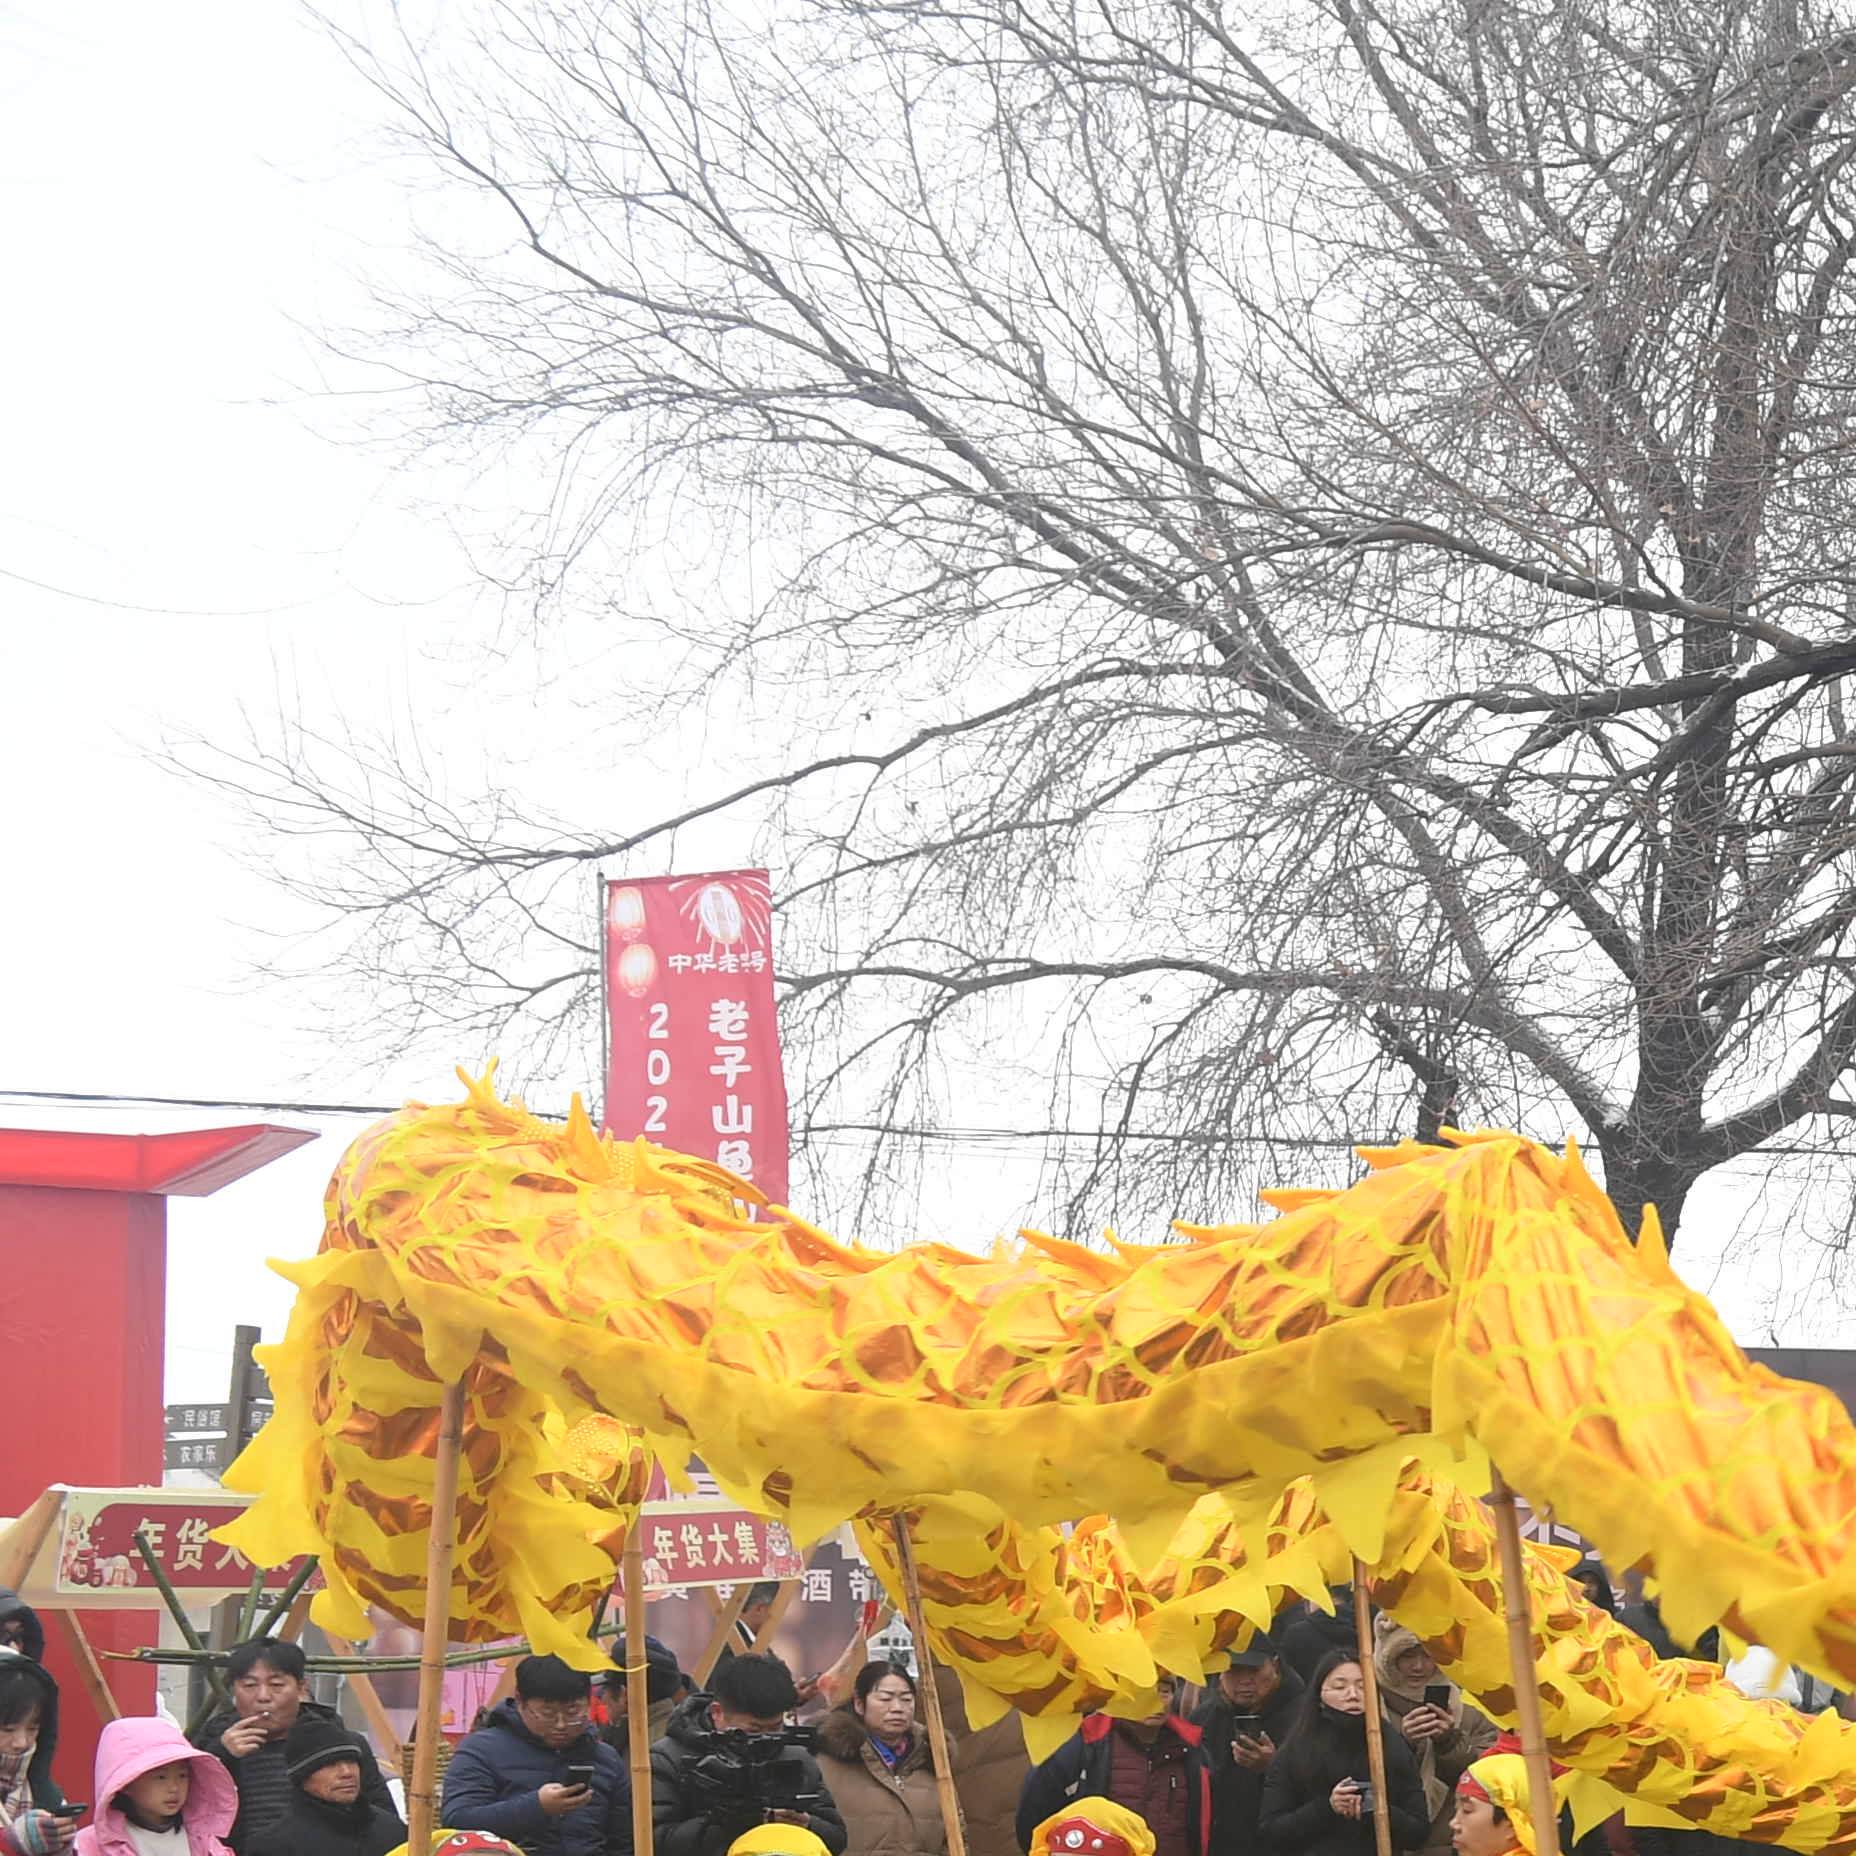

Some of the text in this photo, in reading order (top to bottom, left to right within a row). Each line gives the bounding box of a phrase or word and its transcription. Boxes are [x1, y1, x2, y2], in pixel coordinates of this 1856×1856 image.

[643, 1003, 672, 1148] 202
[129, 1517, 292, 1572] 年货
[652, 1520, 760, 1570] 年货大集
